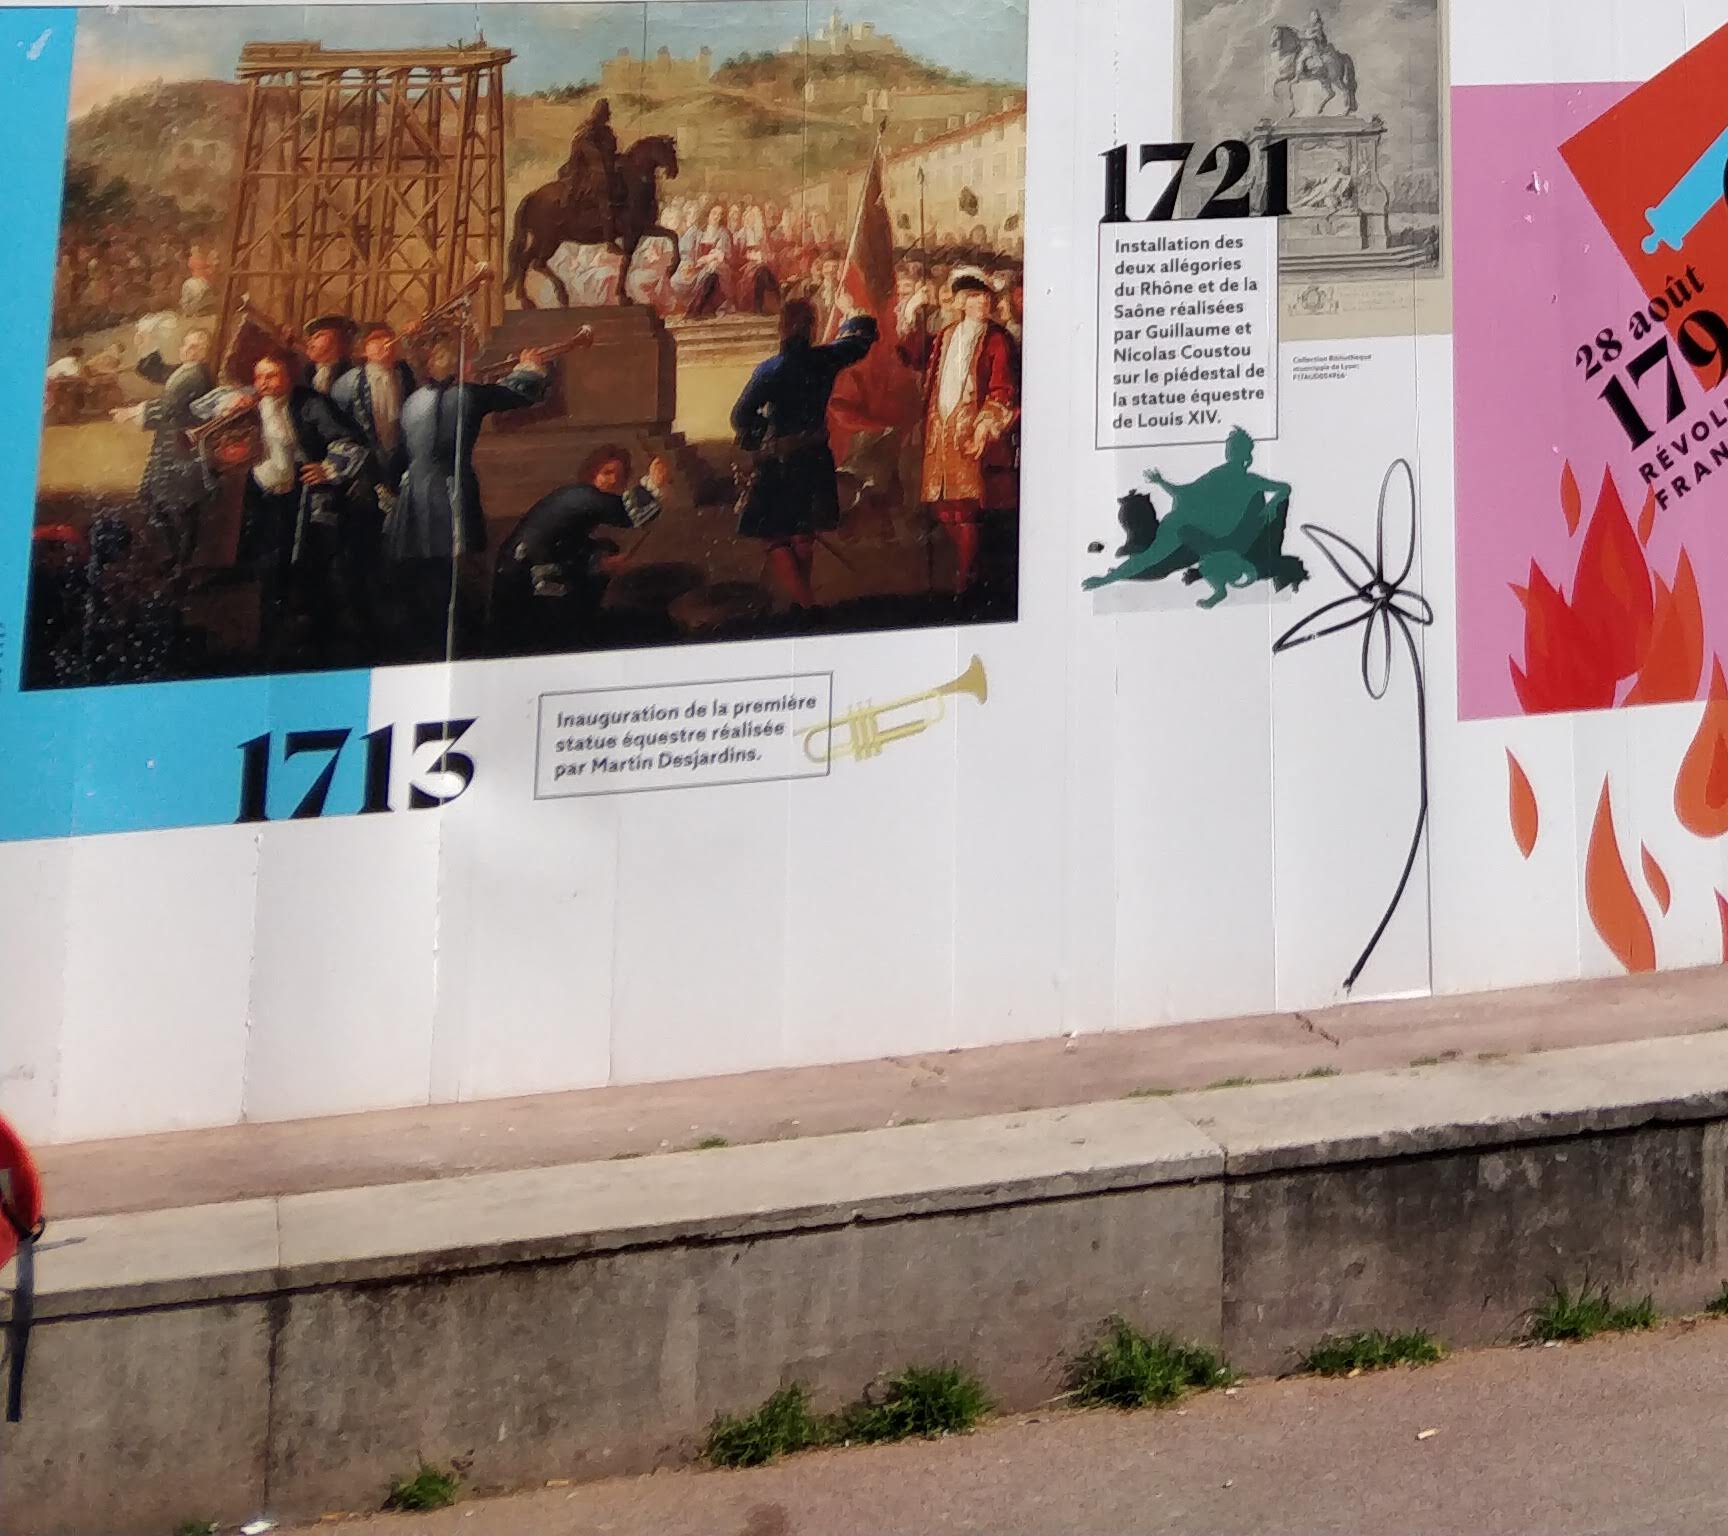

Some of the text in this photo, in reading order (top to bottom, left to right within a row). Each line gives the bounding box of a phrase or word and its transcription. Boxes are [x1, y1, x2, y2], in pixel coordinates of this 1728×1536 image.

[1097, 138, 1293, 223] 1721
[1115, 233, 1243, 253] Installation des
[1114, 255, 1241, 276] deux allégories
[1113, 276, 1257, 297] du Rhône et de la
[1113, 298, 1244, 319] Saône réalisées
[1113, 321, 1251, 345] par Guillaume et
[1575, 264, 1705, 381] 28 août
[1113, 344, 1250, 363] Nicolas Coustou
[1112, 362, 1265, 386] sur le piédestal de
[1112, 387, 1264, 407] la statue équestre
[1112, 408, 1221, 429] de Louis XIV.
[556, 693, 817, 729] Inauguration de la première
[555, 718, 784, 752] statue équestre réalisée
[233, 716, 481, 825] 1713
[553, 762, 587, 781] par
[590, 752, 653, 774] Martin
